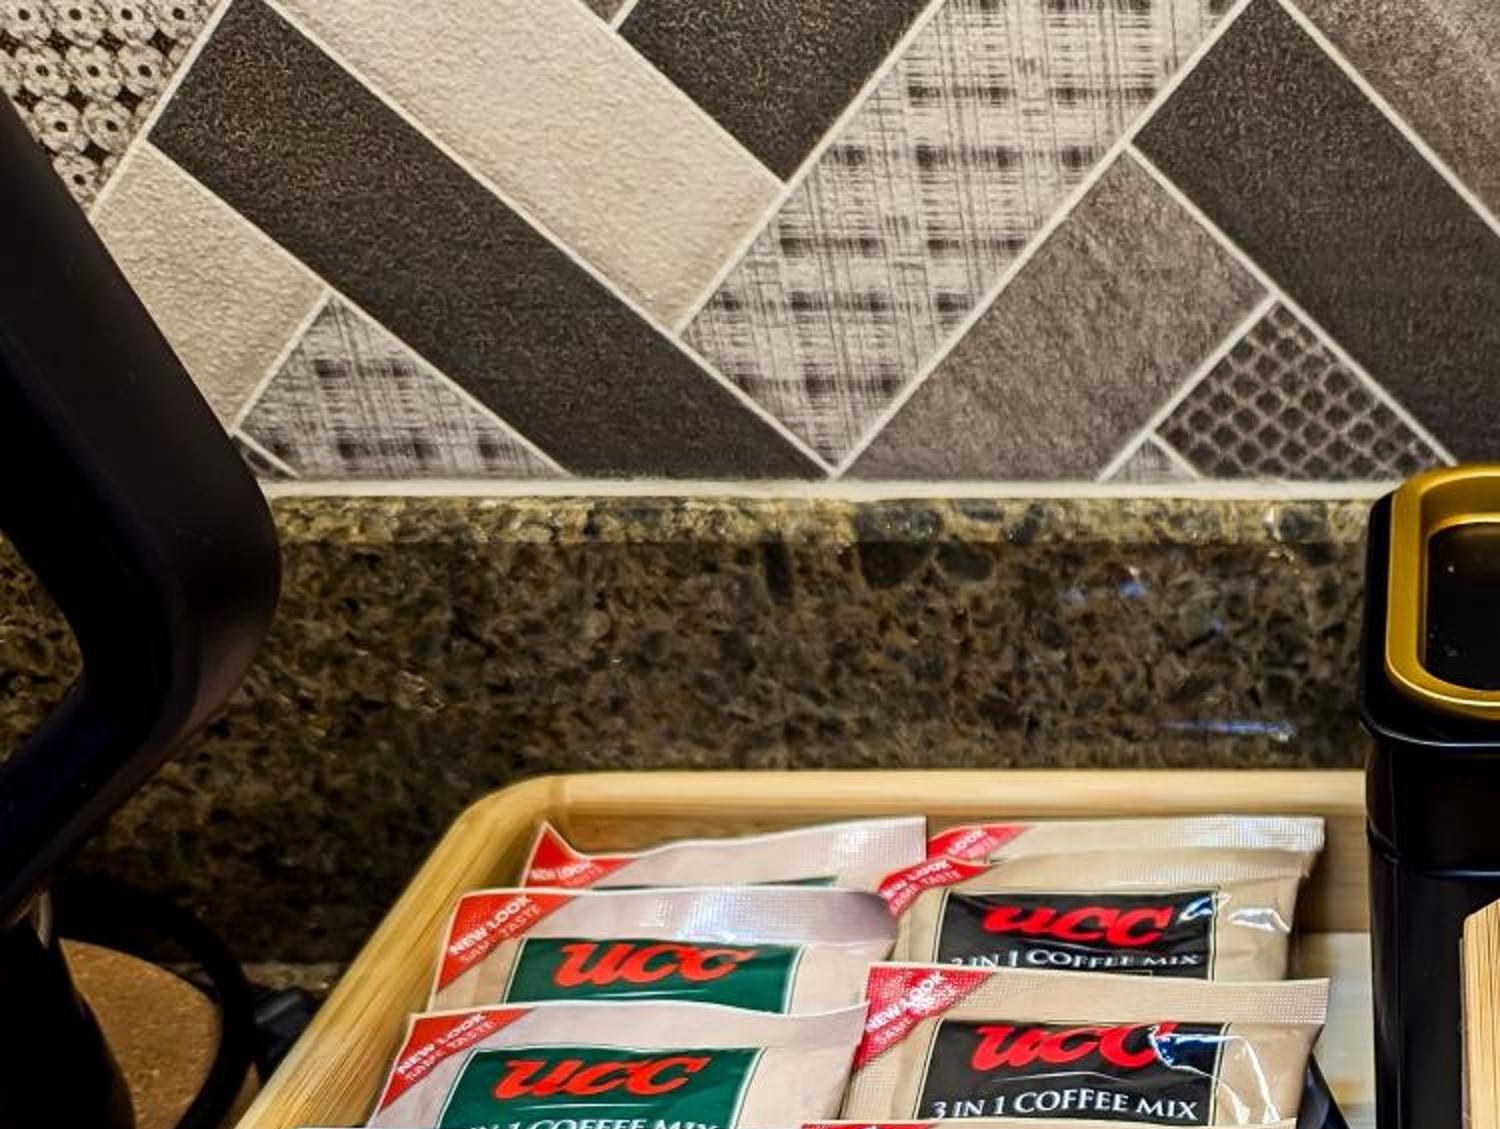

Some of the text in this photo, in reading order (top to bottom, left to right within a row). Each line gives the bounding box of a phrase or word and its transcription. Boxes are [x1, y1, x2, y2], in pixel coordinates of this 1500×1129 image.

[448, 894, 532, 956] NEW LOOK
[1025, 948, 1136, 969] COFFEE
[1143, 953, 1200, 966] MIX
[865, 1003, 900, 1033] NEW
[398, 1042, 436, 1075] NEW
[930, 1088, 1200, 1121] 3 IN 1 COFFEE MIX
